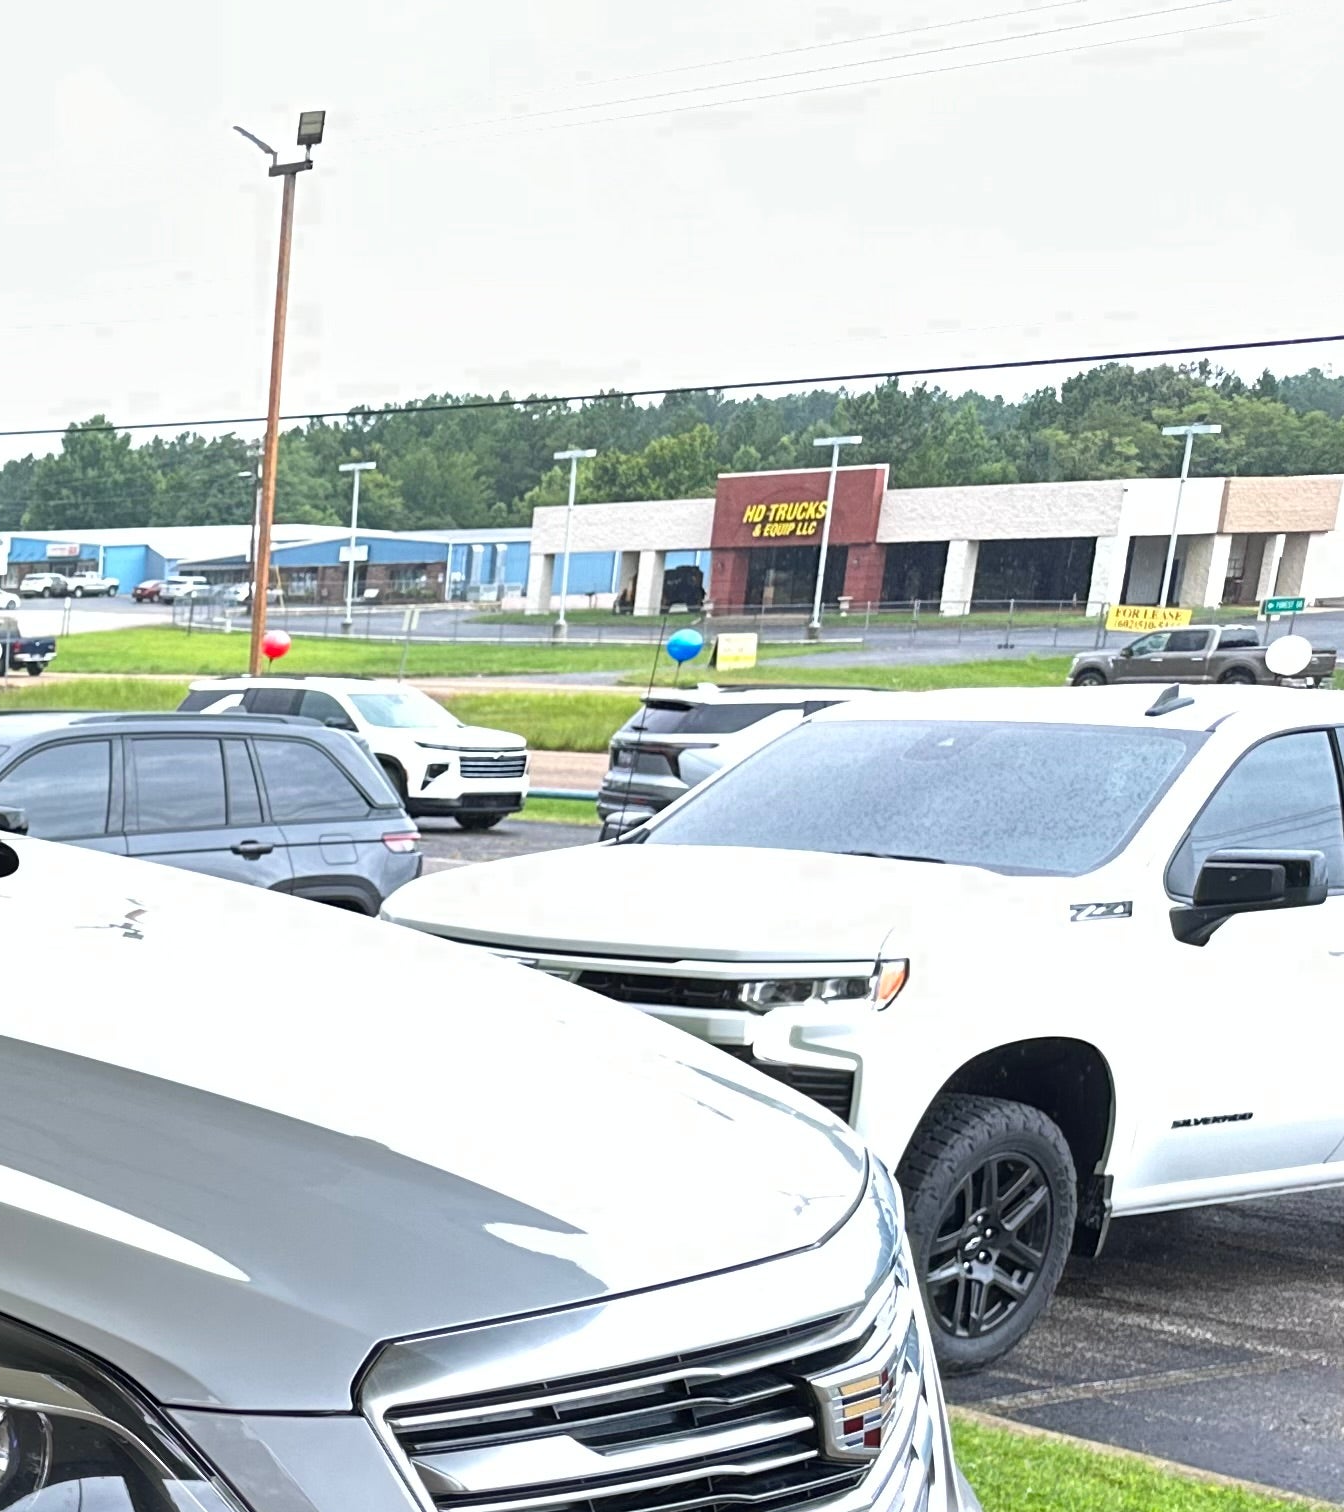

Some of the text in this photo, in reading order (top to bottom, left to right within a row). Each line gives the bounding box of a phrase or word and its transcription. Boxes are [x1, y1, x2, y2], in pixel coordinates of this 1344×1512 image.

[743, 500, 829, 523] HD TRUCKS
[752, 521, 817, 538] & EQUIP LLC
[1115, 608, 1183, 621] FOR LEASE
